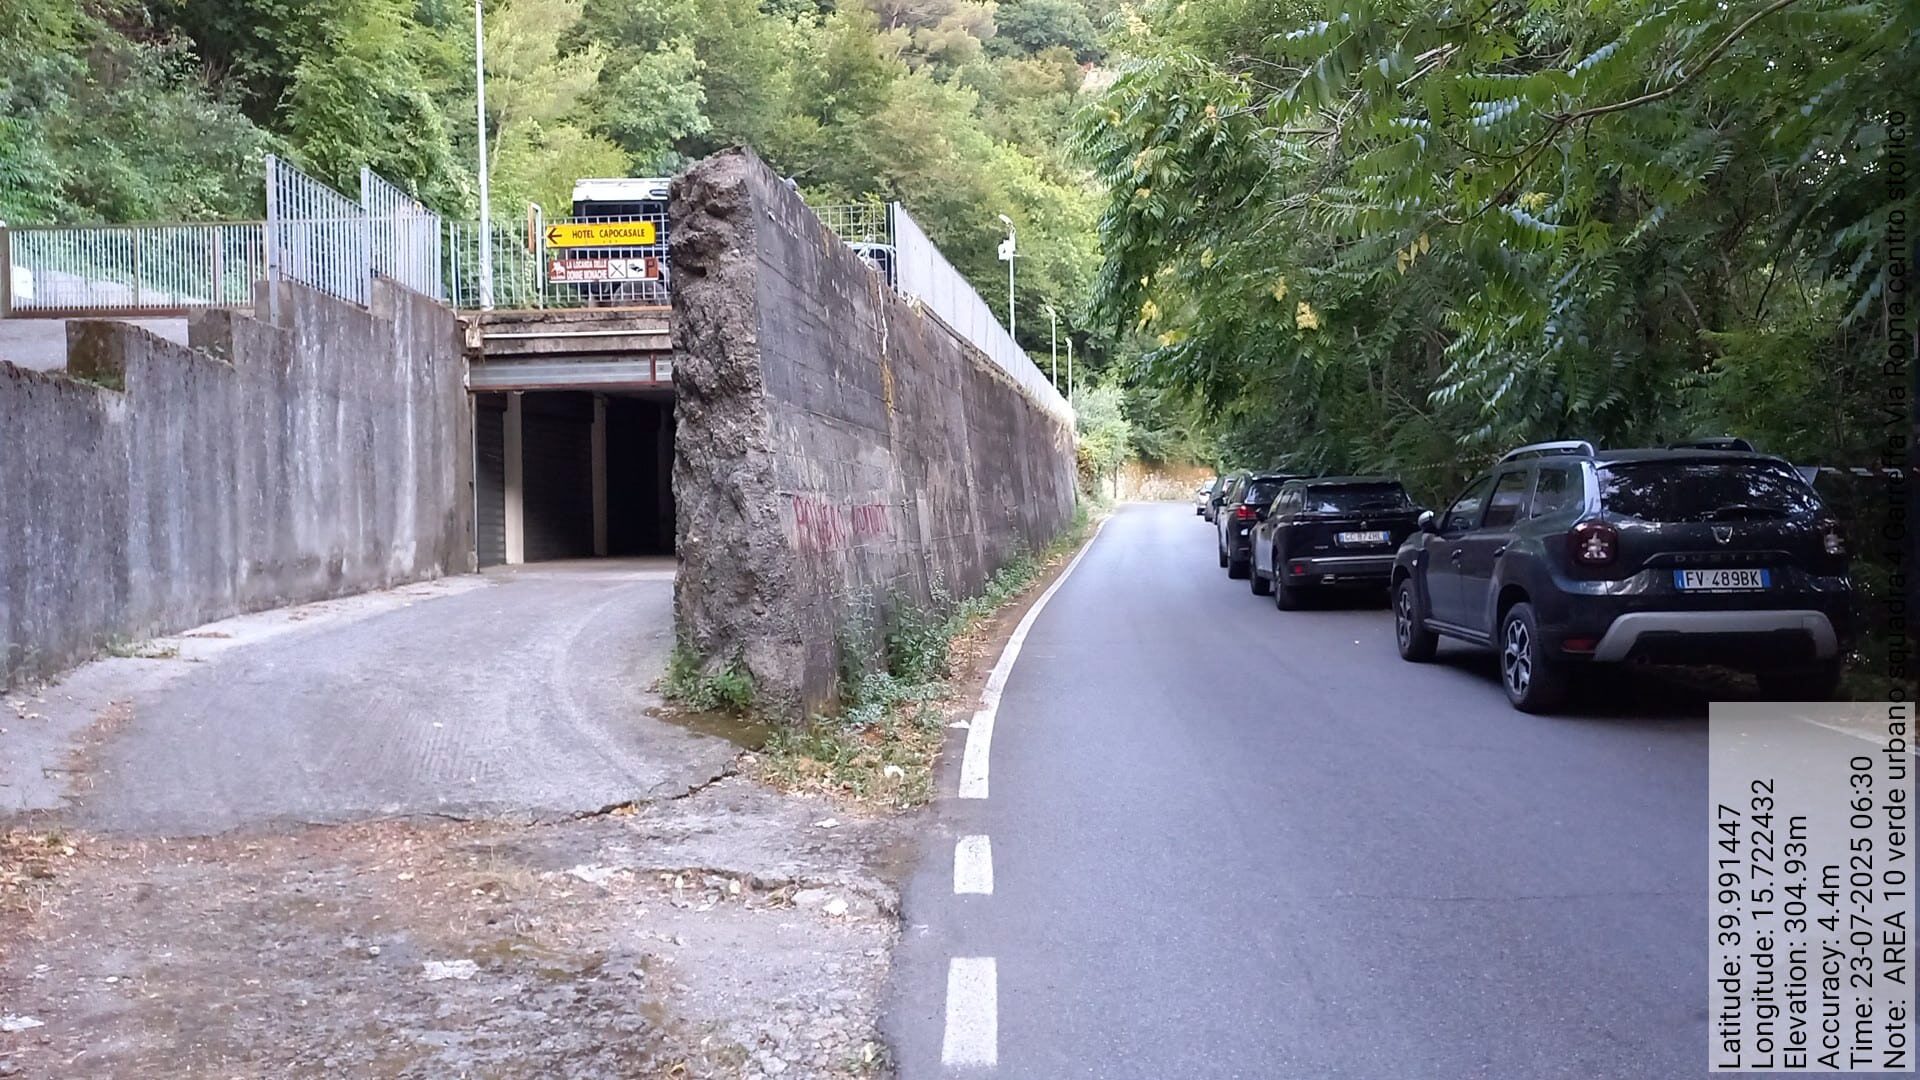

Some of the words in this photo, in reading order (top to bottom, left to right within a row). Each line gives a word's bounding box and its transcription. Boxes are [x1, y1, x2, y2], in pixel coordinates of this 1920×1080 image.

[572, 229, 594, 239] HOTEL
[599, 228, 645, 238] CAPOCASALE
[1686, 572, 1703, 586] FV
[1712, 571, 1760, 586] 489BK
